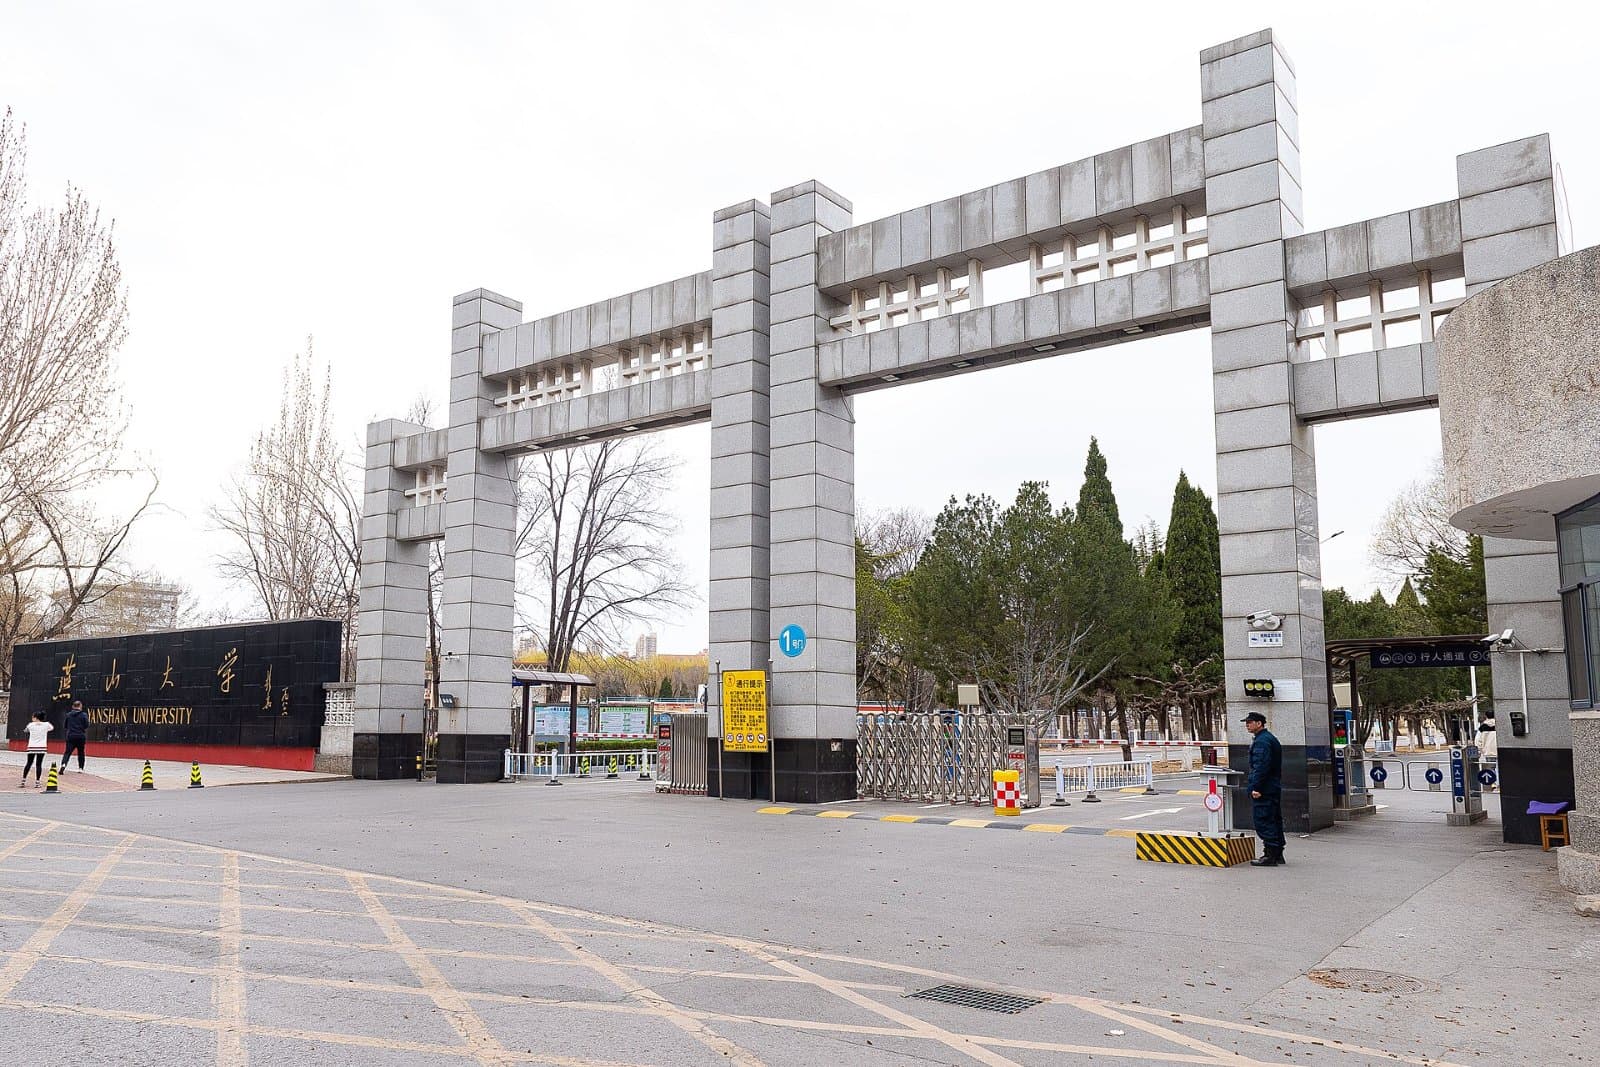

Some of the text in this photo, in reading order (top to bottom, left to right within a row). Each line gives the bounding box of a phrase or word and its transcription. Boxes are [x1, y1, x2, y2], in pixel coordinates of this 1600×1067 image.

[1421, 651, 1465, 662] 行人通道
[53, 648, 239, 700] 燕山大学
[87, 707, 193, 725] YANSHAN UNIVERSITY
